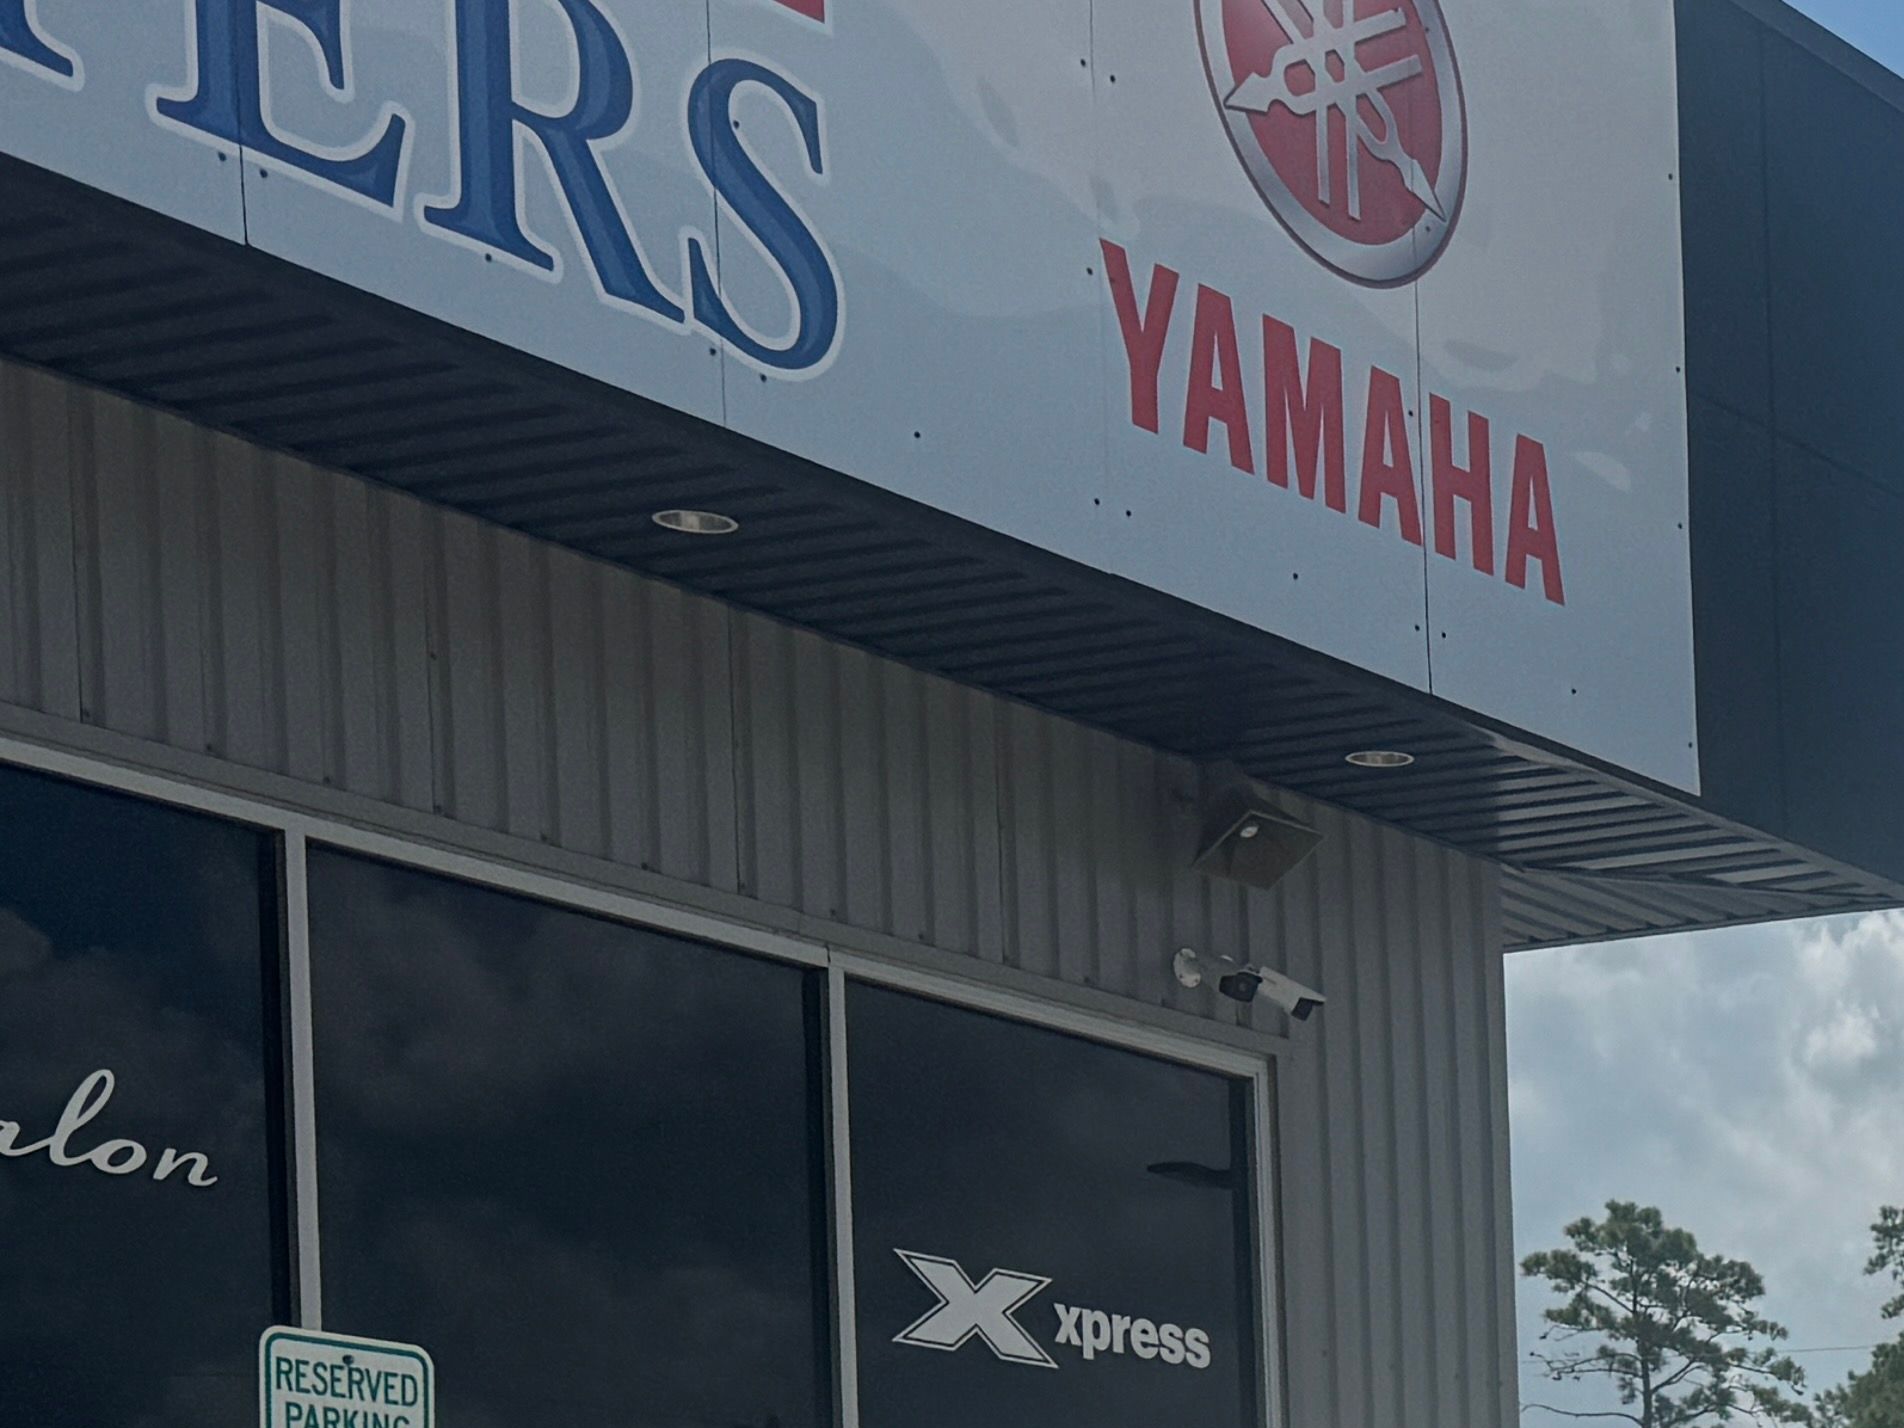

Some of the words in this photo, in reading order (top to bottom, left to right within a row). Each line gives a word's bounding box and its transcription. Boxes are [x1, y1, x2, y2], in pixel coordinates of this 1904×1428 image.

[0, 0, 841, 370] ERS
[1100, 237, 1565, 606] YAMAHA
[275, 1356, 419, 1407] RESERVED
[1053, 1302, 1211, 1369] xpress
